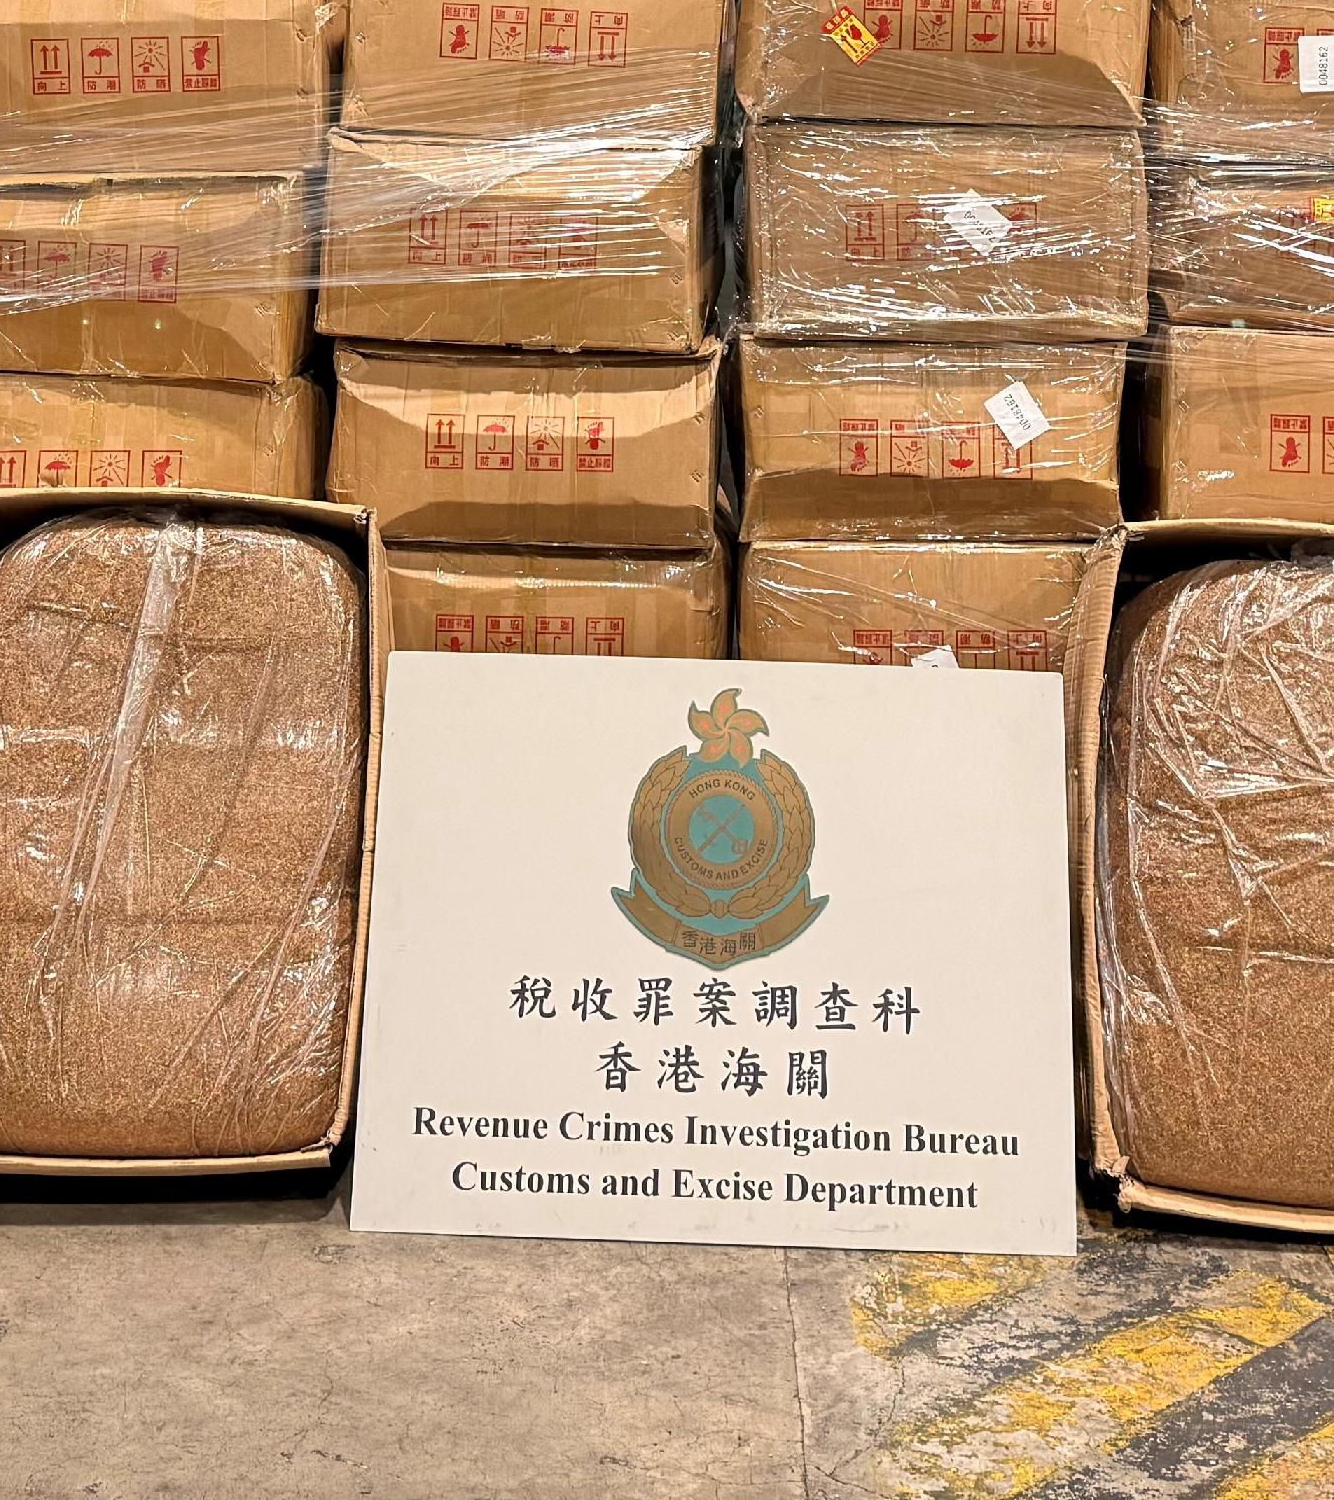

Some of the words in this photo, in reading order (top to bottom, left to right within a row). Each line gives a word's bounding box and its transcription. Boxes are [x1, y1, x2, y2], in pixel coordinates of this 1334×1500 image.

[444, 7, 477, 18] 禁止踩踏
[496, 9, 525, 20] 防晒
[544, 12, 574, 23] 防潮
[594, 14, 623, 25] 向上
[1318, 46, 1328, 86] 0048162
[37, 81, 66, 91] 向上
[430, 456, 458, 467] 向上
[479, 456, 509, 467] 防潮
[529, 457, 558, 468] 防晒
[590, 620, 620, 631] 向上
[689, 778, 721, 798] HONG
[725, 779, 756, 801] KONG
[674, 837, 714, 879] CUSTOMS
[715, 869, 739, 880] AND
[741, 839, 768, 874] EXCISE
[682, 929, 757, 956] 香港海關
[509, 974, 921, 1035] 稅收罪案調查科
[593, 1040, 829, 1100] 香港海關
[412, 1106, 549, 1140] Revenue
[559, 1111, 674, 1144] Crimes
[684, 1115, 891, 1157] Investigation
[902, 1123, 1020, 1156] Bureau
[452, 1161, 591, 1195] Customs
[601, 1168, 660, 1197] and
[671, 1168, 773, 1201] Excise
[783, 1172, 979, 1212] Department
